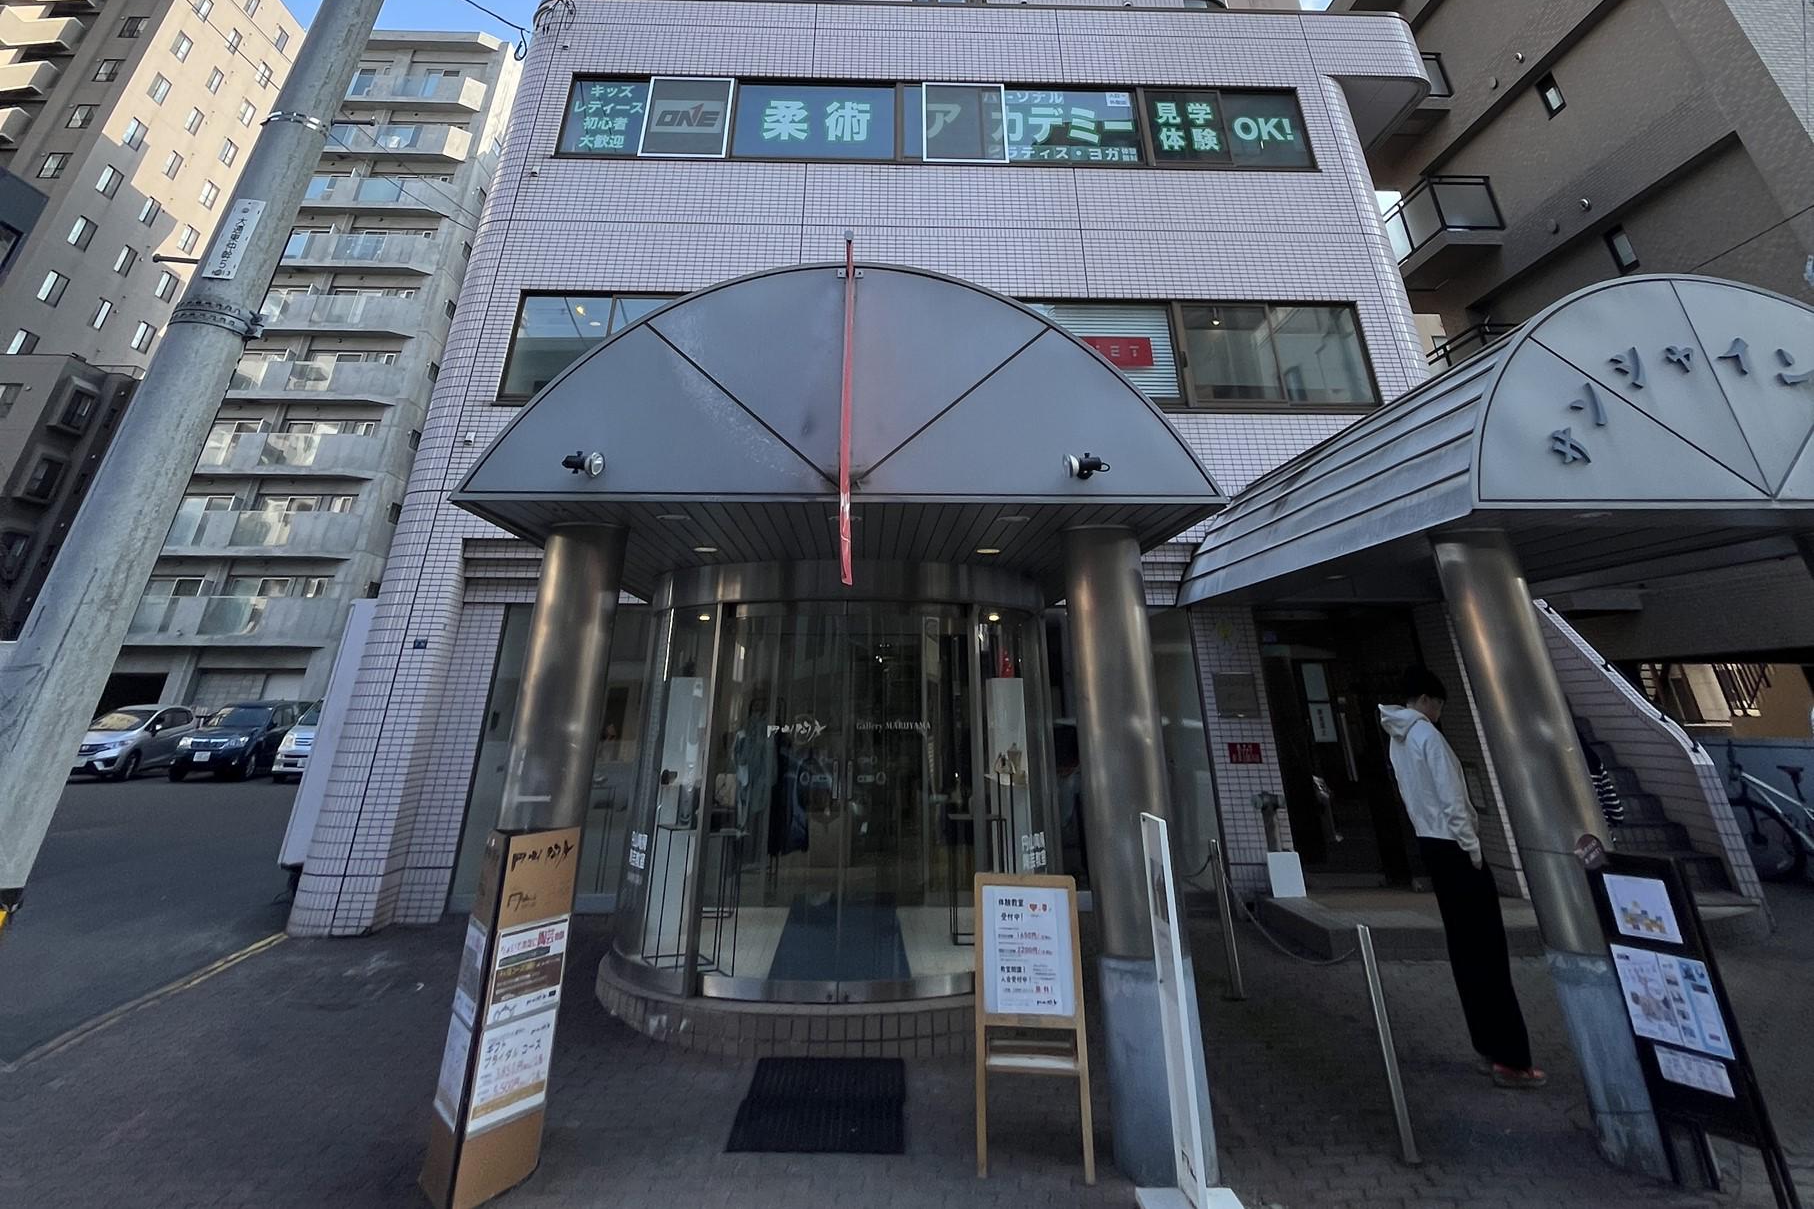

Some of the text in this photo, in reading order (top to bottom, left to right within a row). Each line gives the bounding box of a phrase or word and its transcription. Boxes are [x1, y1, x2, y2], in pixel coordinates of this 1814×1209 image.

[591, 85, 635, 97] キッズ
[574, 101, 643, 114] レディース
[656, 103, 720, 127] ONE
[1155, 102, 1213, 124] 見学
[583, 116, 628, 130] 初心者
[763, 100, 1133, 143] 柔術 アカデミー
[1233, 117, 1294, 140] OK!
[578, 134, 625, 148] 大歓迎
[1160, 127, 1219, 151] 体験
